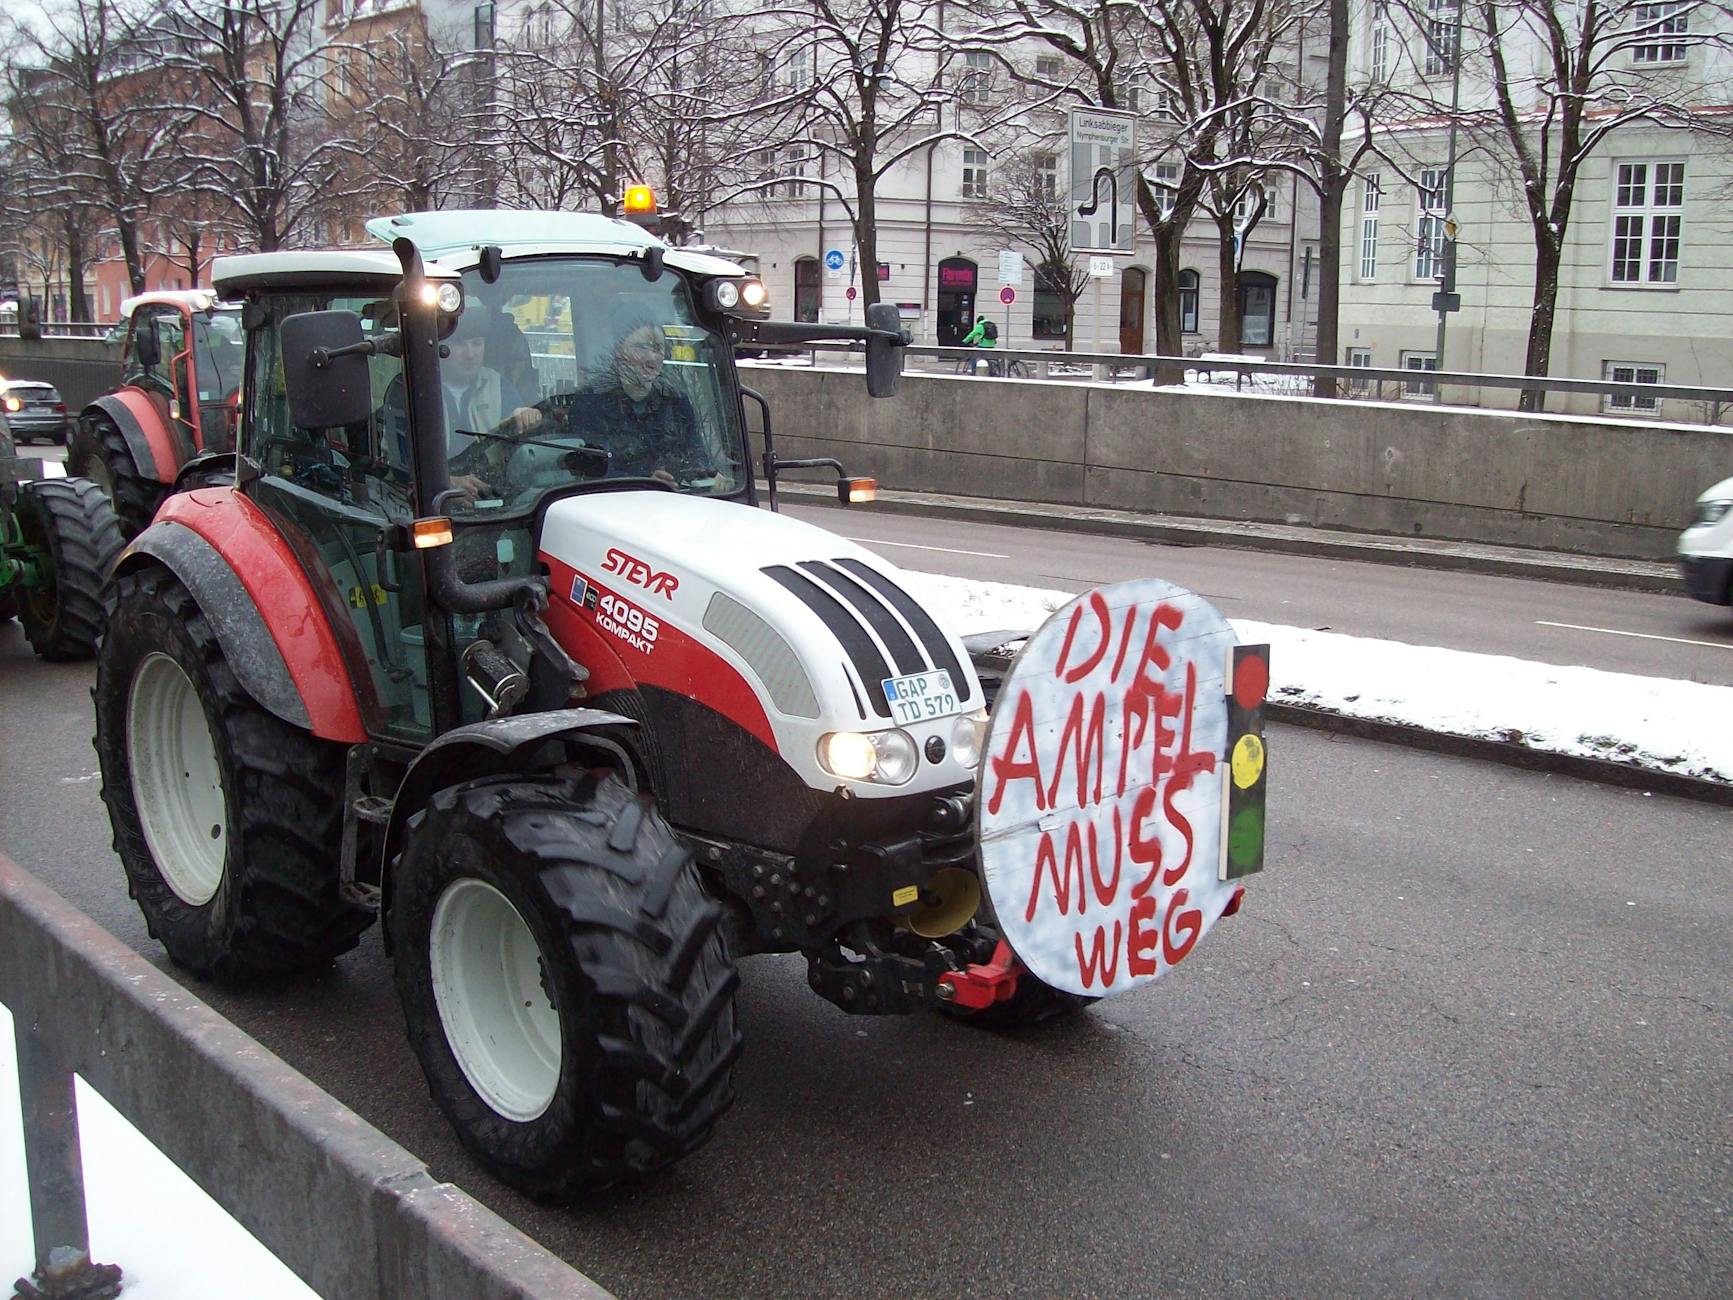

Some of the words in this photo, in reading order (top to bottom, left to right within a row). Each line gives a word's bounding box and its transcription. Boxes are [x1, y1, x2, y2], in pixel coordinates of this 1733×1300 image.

[1079, 116, 1128, 134] Linksabbieger
[600, 547, 681, 601] STEYR
[595, 612, 654, 655] KOMPAKT
[600, 594, 660, 642] 4095
[1055, 590, 1184, 697] DIE
[896, 678, 927, 699] GAP
[898, 701, 921, 721] TD
[924, 694, 954, 716] 579
[988, 660, 1216, 815] AMPEL
[1025, 773, 1194, 922] MUSS
[1075, 889, 1203, 989] WEG
